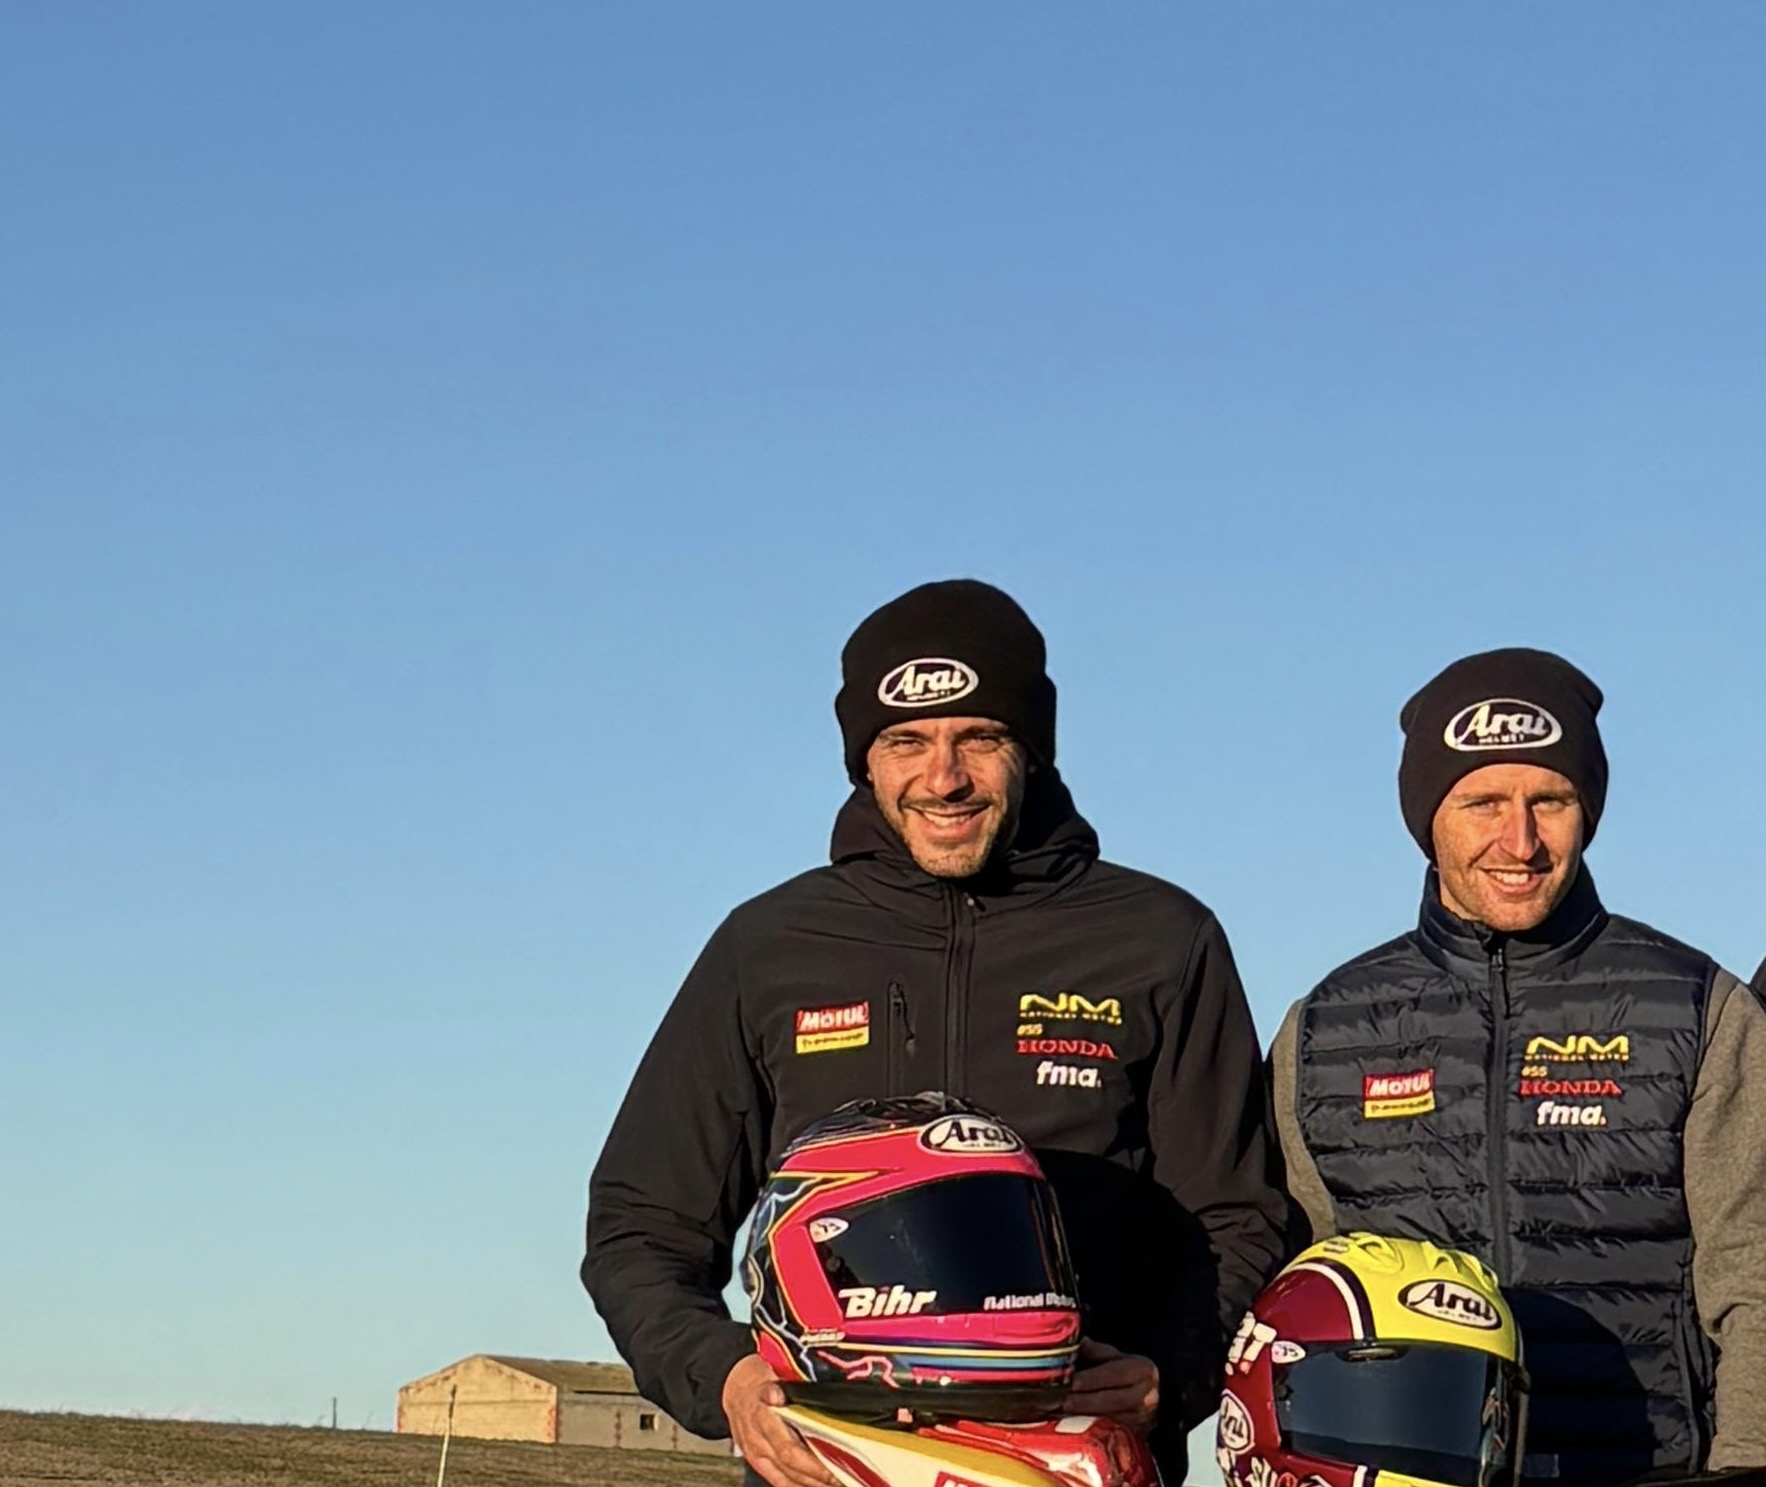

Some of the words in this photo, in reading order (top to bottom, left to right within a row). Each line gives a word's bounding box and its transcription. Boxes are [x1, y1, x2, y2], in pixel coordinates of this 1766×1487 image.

[890, 665, 966, 698] Arai
[1458, 703, 1549, 742] Arai
[1020, 992, 1121, 1017] NM
[799, 1004, 865, 1032] MOTUL
[1017, 1039, 1119, 1060] HONDA
[1525, 1034, 1630, 1055] NM
[1369, 1072, 1430, 1097] MOTUL
[1519, 1080, 1623, 1096] HONDA
[838, 1284, 938, 1319] Bihr
[1408, 1283, 1494, 1321] Arai
